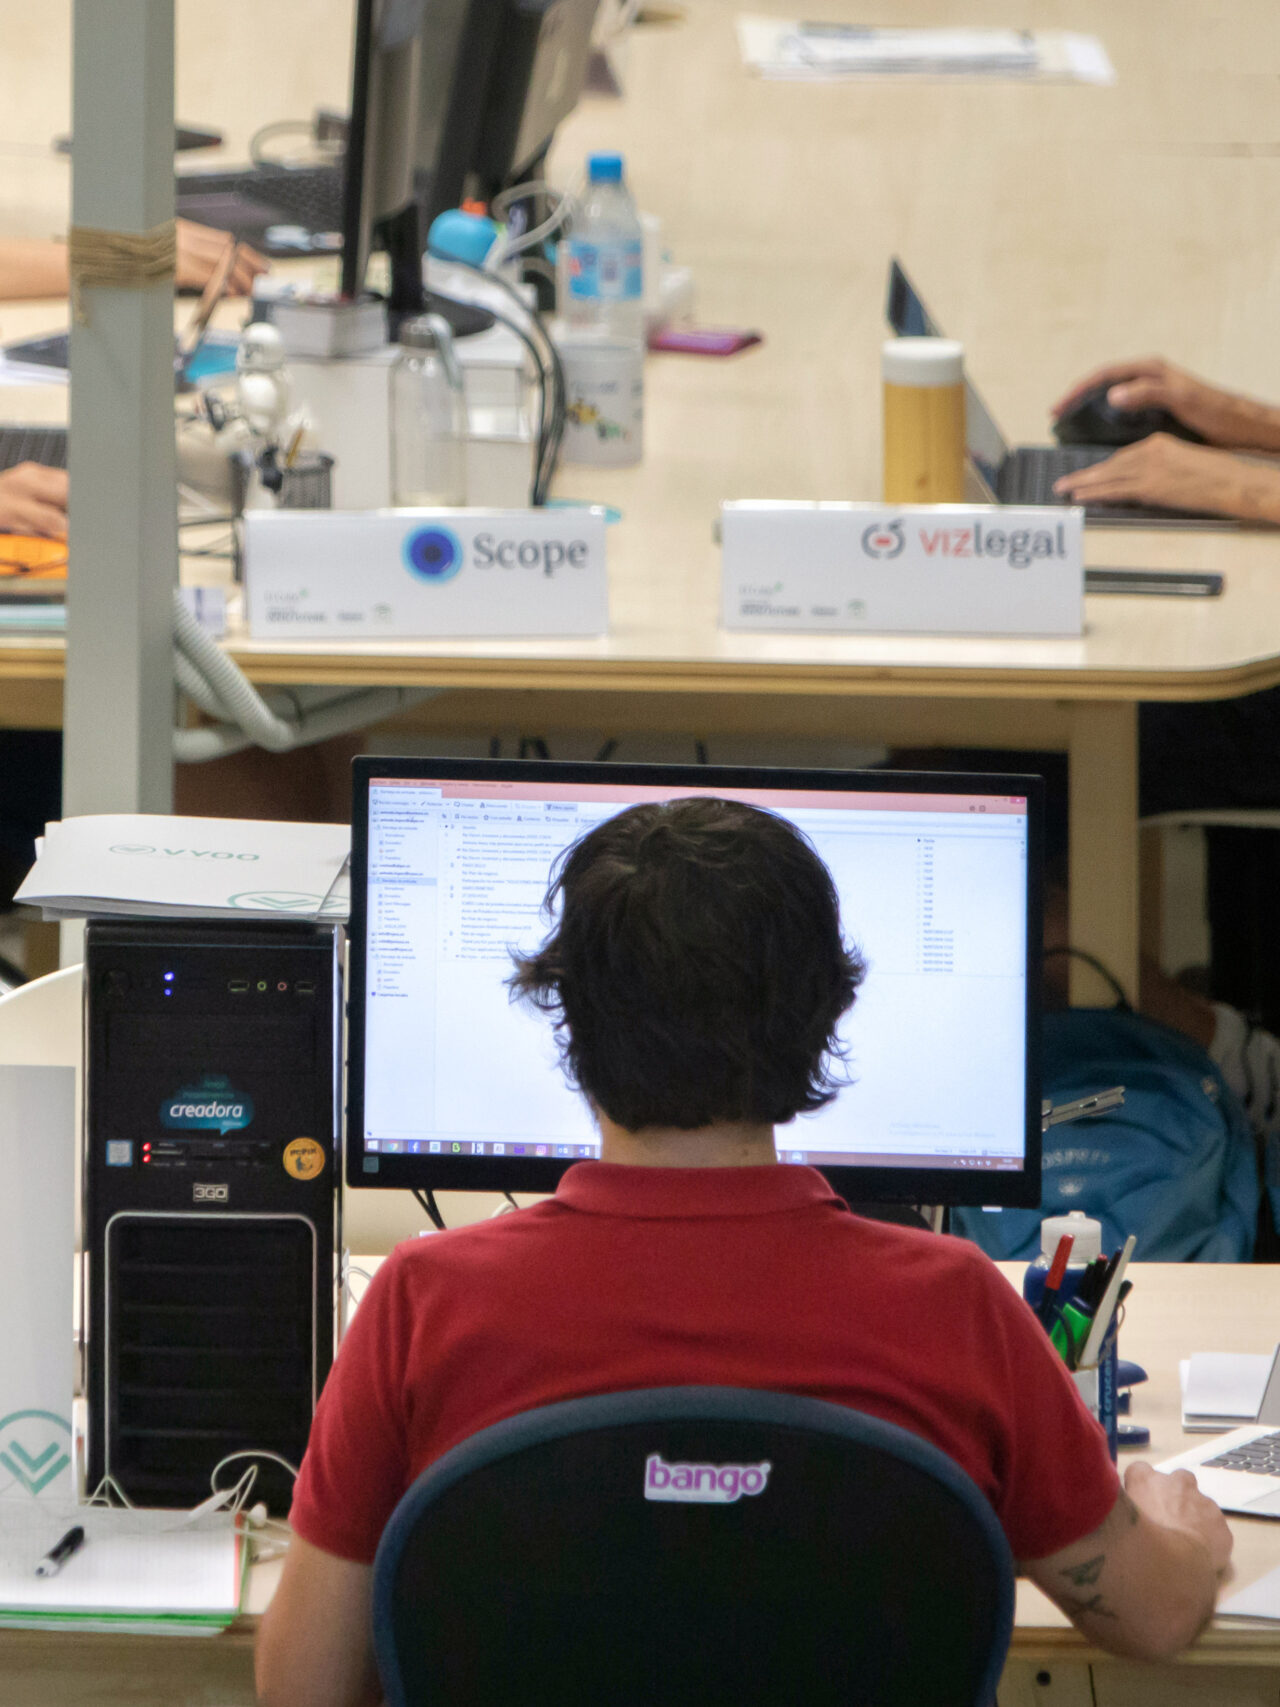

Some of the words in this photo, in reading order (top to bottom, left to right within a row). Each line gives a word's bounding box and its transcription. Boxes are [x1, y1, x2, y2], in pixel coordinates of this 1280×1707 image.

[472, 532, 588, 578] Scope
[919, 520, 1067, 569] vizlegal
[162, 848, 260, 861] VYOO
[169, 1101, 244, 1119] creadora
[647, 1458, 764, 1501] bango
